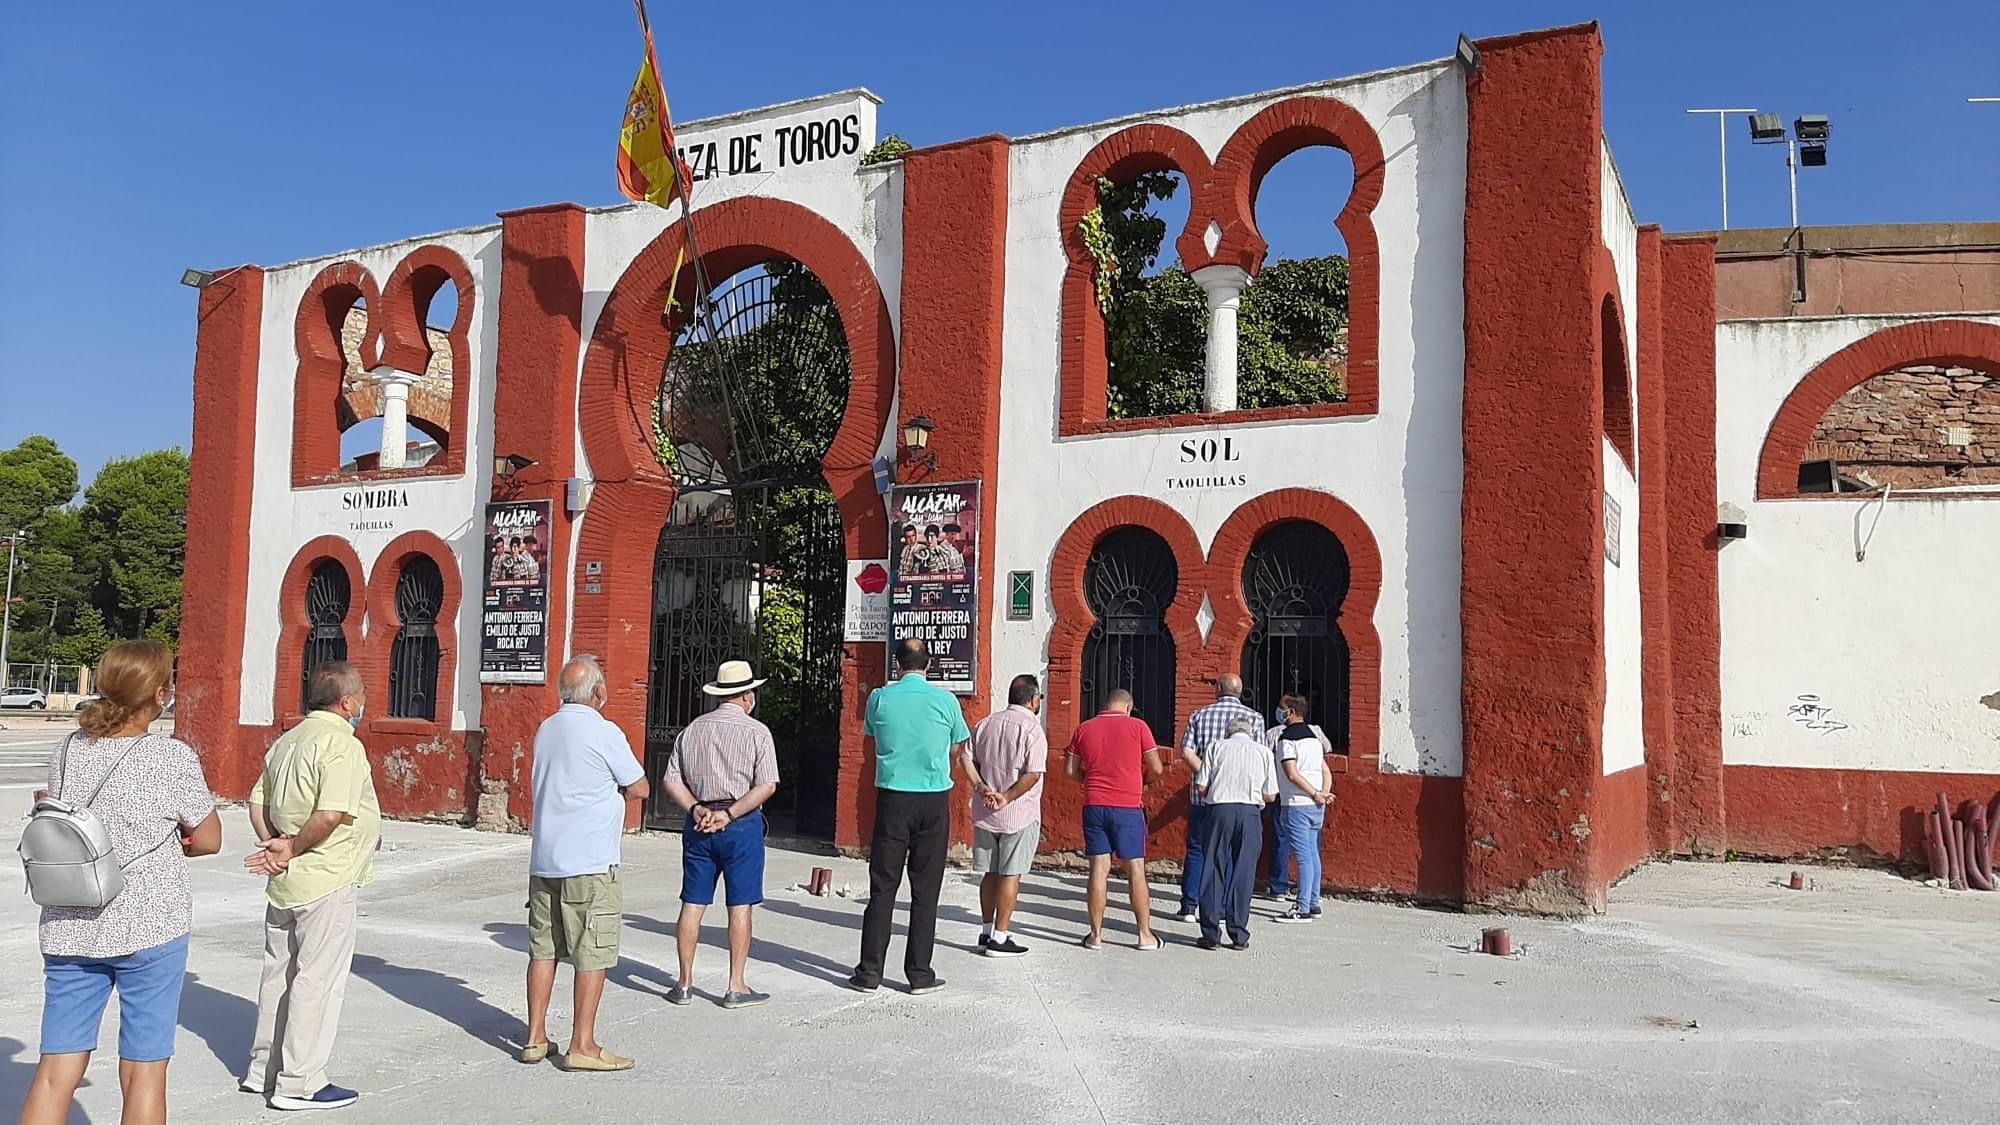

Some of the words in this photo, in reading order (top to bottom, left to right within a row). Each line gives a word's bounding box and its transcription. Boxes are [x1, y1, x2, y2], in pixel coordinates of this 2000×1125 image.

[729, 133, 762, 176] DE
[775, 114, 860, 167] TOROS
[1180, 437, 1240, 463] SOL
[1166, 474, 1246, 489] TAQUILLAS
[342, 488, 409, 511] SOMBRA
[901, 492, 961, 513] ALCÁZAR
[350, 520, 394, 531] TAQUILLAS
[907, 584, 913, 598] 5
[484, 611, 514, 624] ANTONIO
[513, 610, 543, 624] FERRERA
[892, 611, 930, 625] ANTONIO
[931, 610, 971, 624] FERRERA
[509, 624, 519, 637] DE
[518, 623, 541, 637] JUSTO
[925, 625, 938, 640] DE
[938, 625, 967, 640] JUSTO
[496, 637, 515, 649] ROCA
[515, 636, 529, 649] REY
[934, 640, 952, 655] REY
